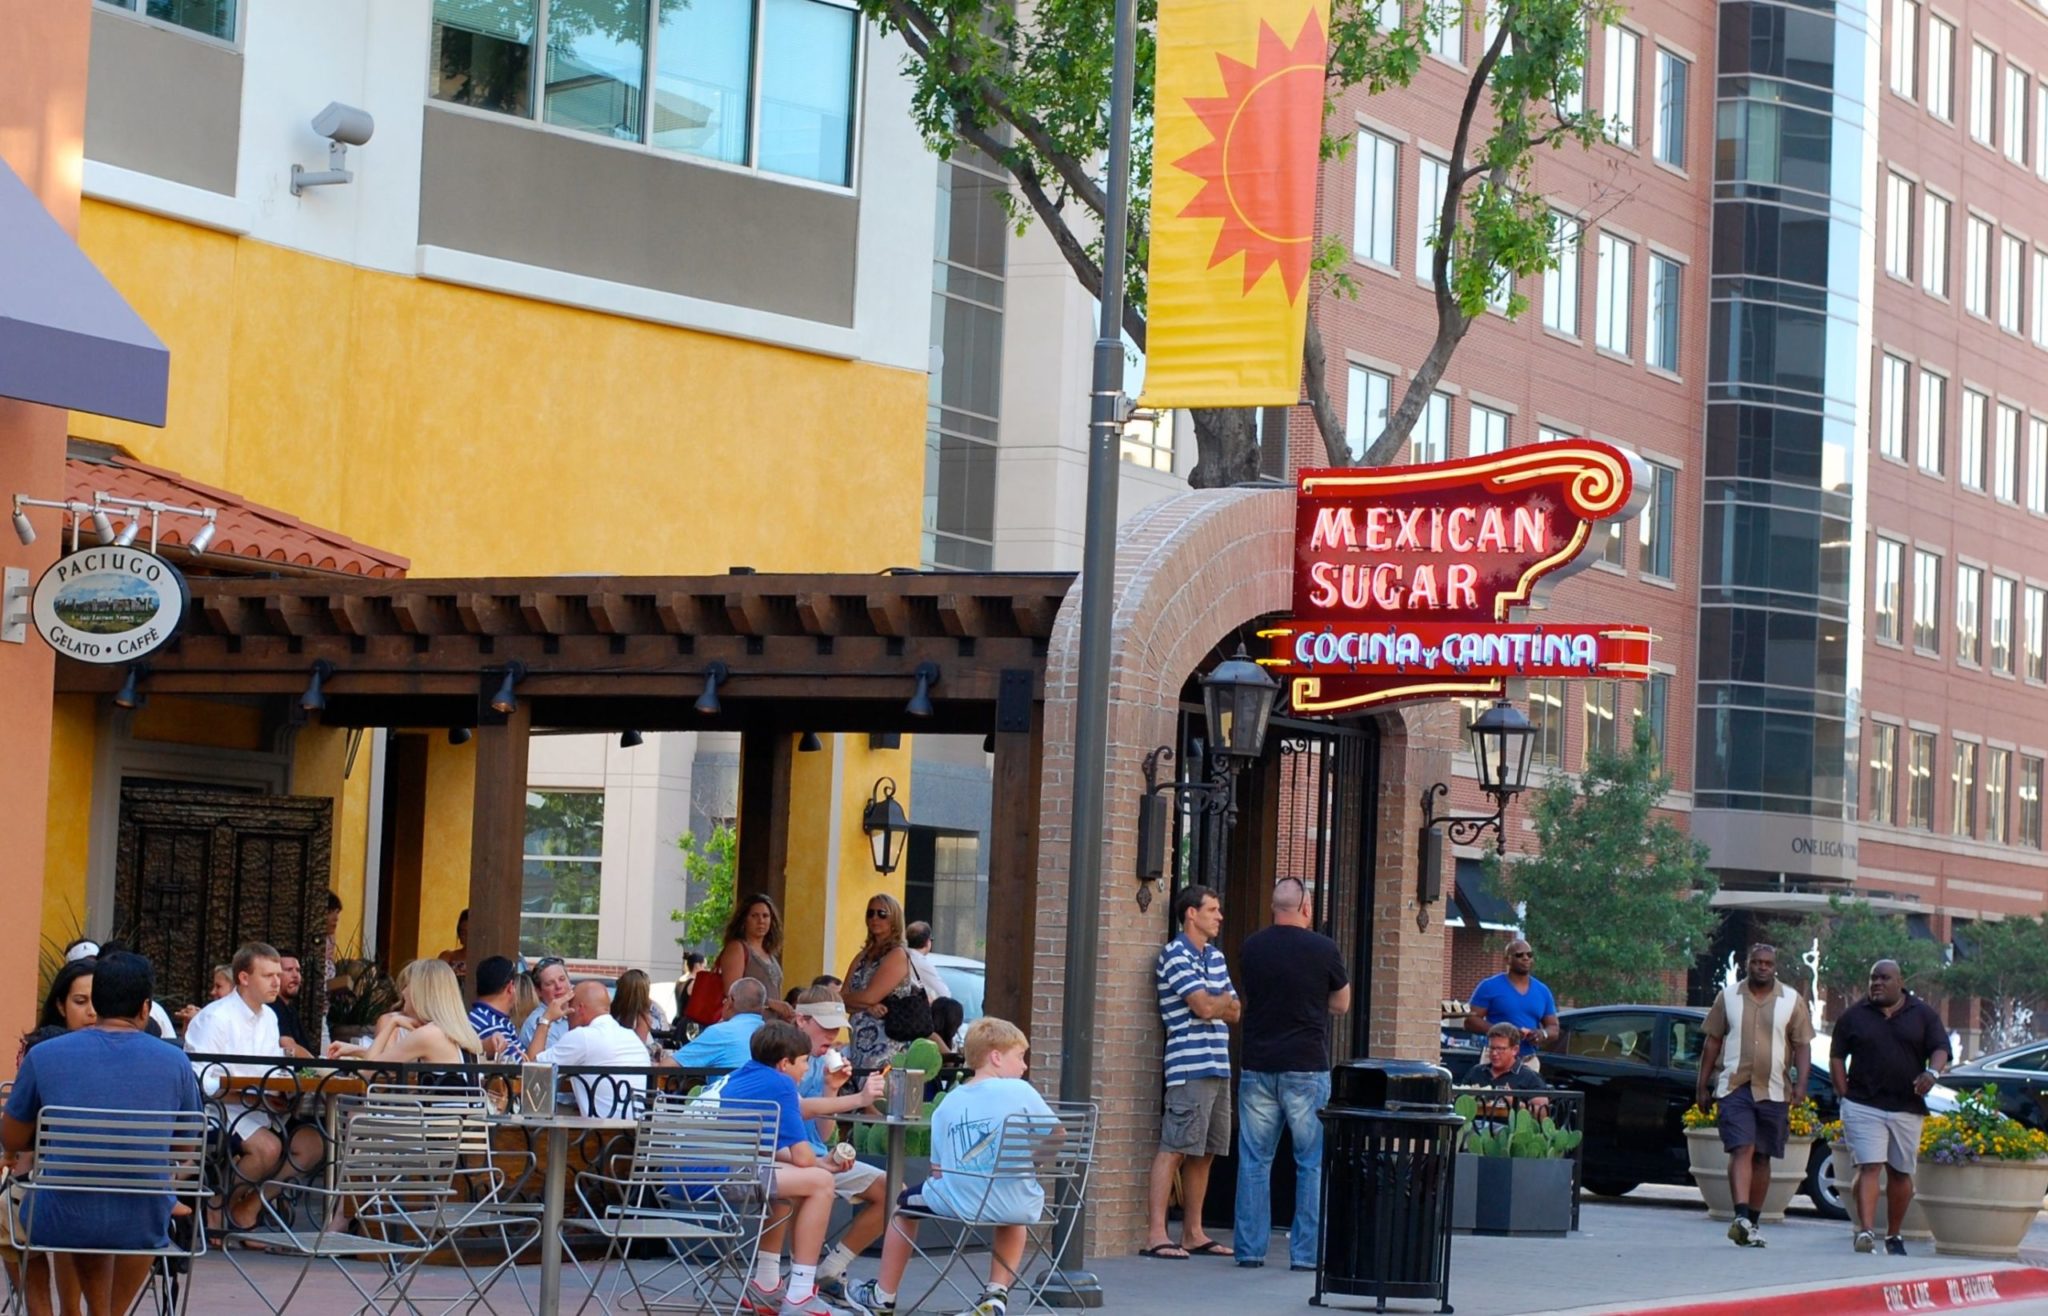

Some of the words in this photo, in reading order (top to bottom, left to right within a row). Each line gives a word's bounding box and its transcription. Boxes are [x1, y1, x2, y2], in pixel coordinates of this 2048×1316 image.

[1310, 507, 1549, 553] MEXICAN
[58, 553, 160, 582] PACIUGO
[1310, 561, 1478, 610] SUGAR
[50, 626, 100, 656] GELATO
[118, 628, 158, 655] CAFFÈ
[1295, 632, 1421, 667] COCINA
[1442, 633, 1597, 667] CANTINA
[1793, 837, 1817, 855] ONE
[1883, 1285, 1909, 1313] FIRE
[1906, 1282, 1936, 1309] LANE
